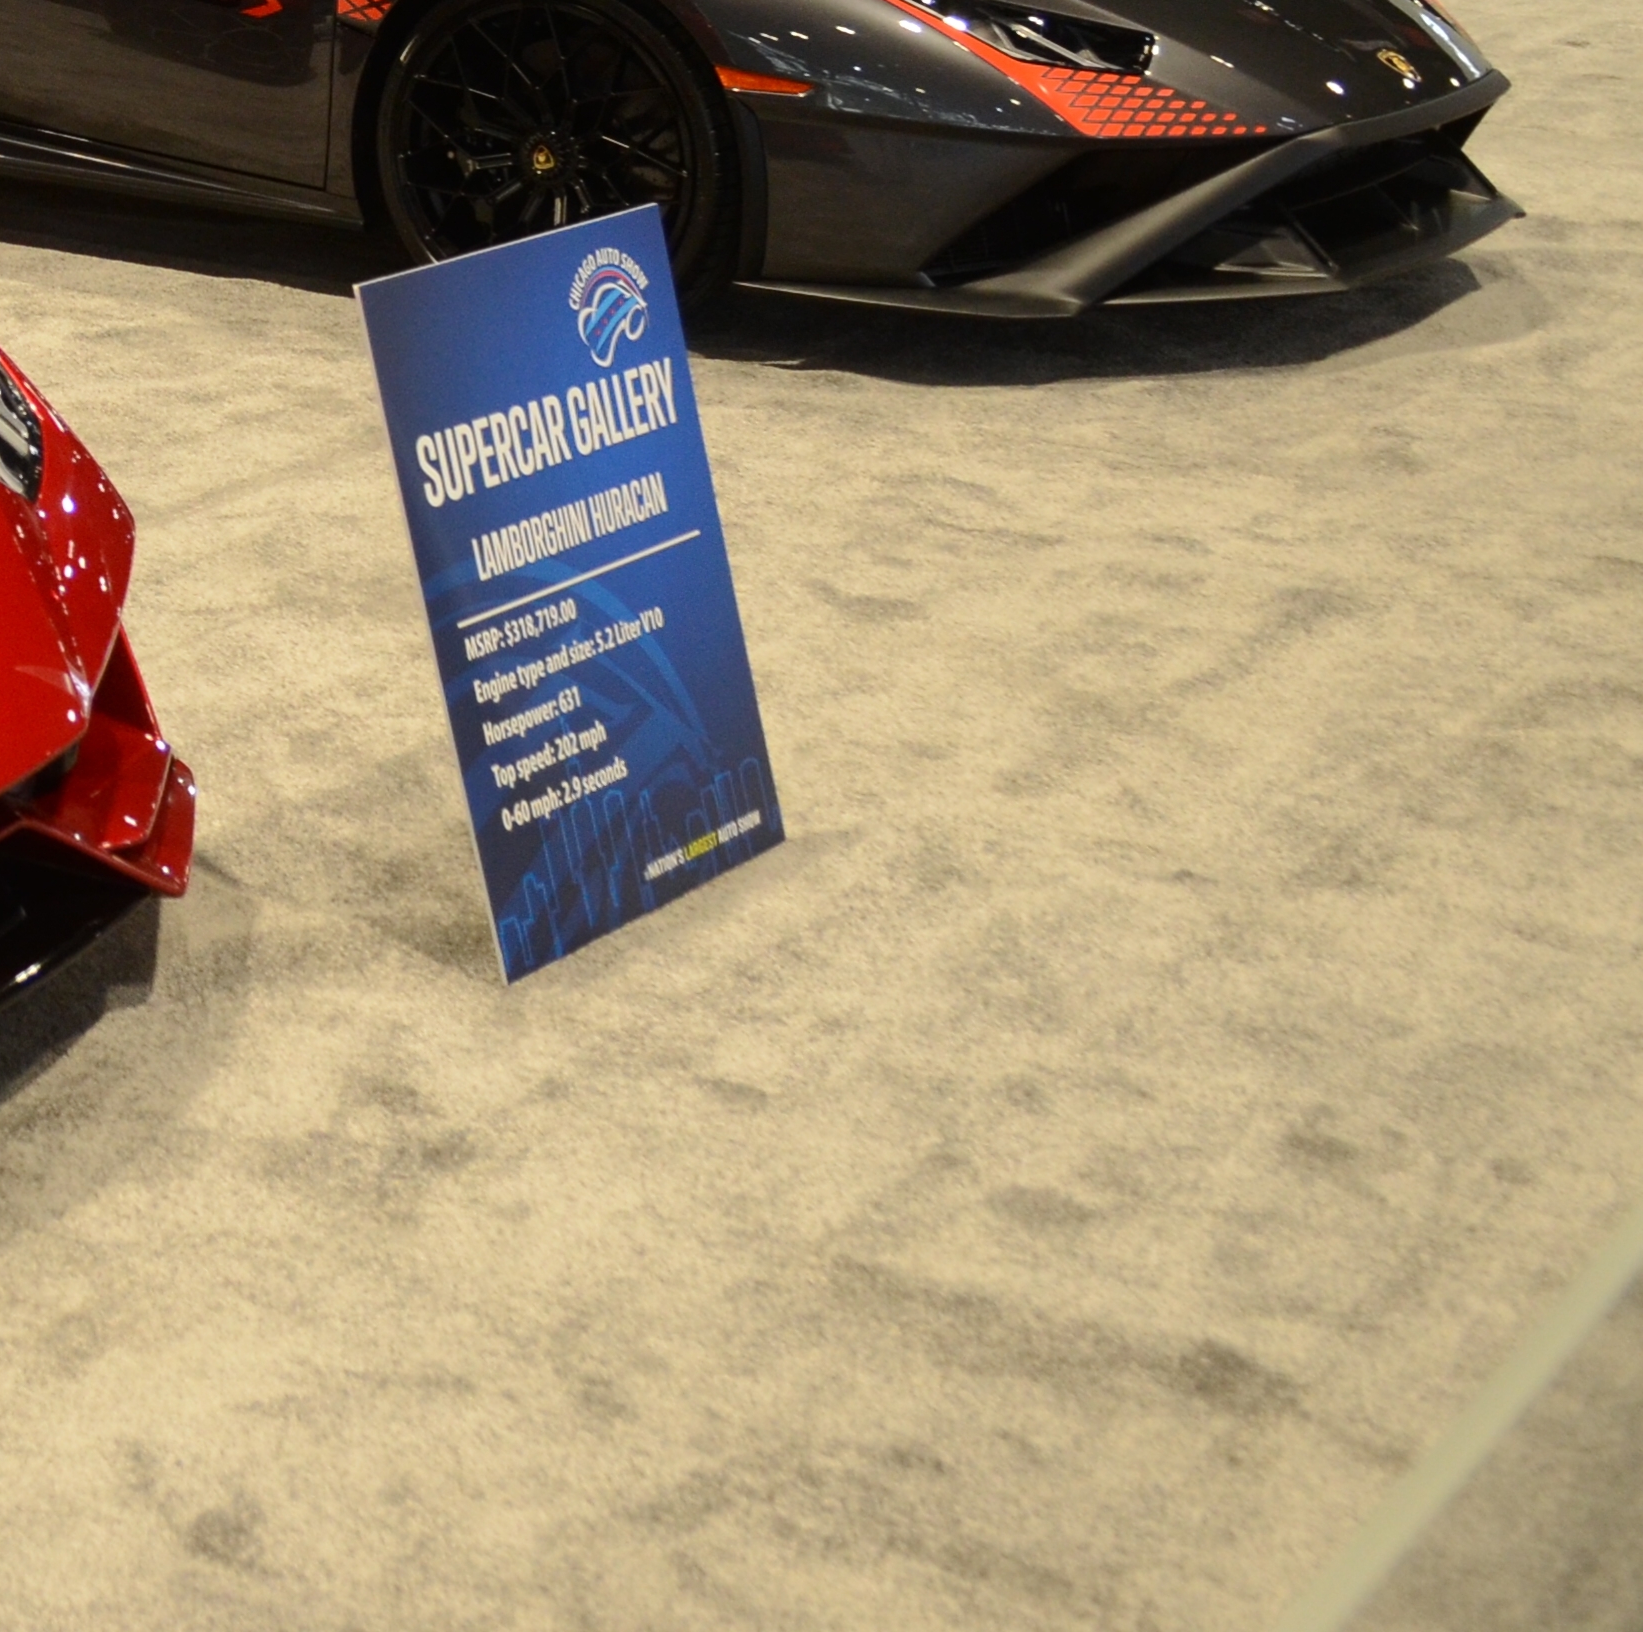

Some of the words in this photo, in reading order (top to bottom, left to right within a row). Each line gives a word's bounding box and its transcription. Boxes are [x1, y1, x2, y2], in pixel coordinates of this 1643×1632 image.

[569, 254, 596, 311] CHICAGO
[595, 248, 620, 266] AUTO
[620, 253, 649, 290] SHOW
[416, 395, 573, 507] SUPERCAR
[567, 357, 678, 456] GALLERY
[472, 499, 592, 582] LAMBORGHINI
[589, 472, 669, 538] HURACAN
[464, 628, 506, 661] MSRP:
[504, 598, 577, 647] $318,719.00
[473, 672, 517, 704] Engine
[516, 660, 546, 690] type
[545, 645, 569, 673] and
[569, 641, 597, 666] size:
[595, 627, 615, 654] 5.2
[614, 618, 642, 645] Liter
[639, 606, 664, 633] V10
[482, 699, 560, 746] Horsepower:
[558, 685, 582, 714] 631
[491, 763, 516, 789] Top
[515, 742, 557, 782] speed:
[554, 732, 580, 761] 202
[578, 720, 607, 751] mph
[501, 799, 532, 831] 0-60
[530, 787, 563, 819] mph:
[561, 776, 582, 804] 2.9
[581, 756, 628, 795] seconds
[646, 848, 685, 879] NATION'S
[684, 831, 717, 861] LARGEST
[717, 820, 738, 844] AUTO
[737, 809, 761, 834] SHOW
